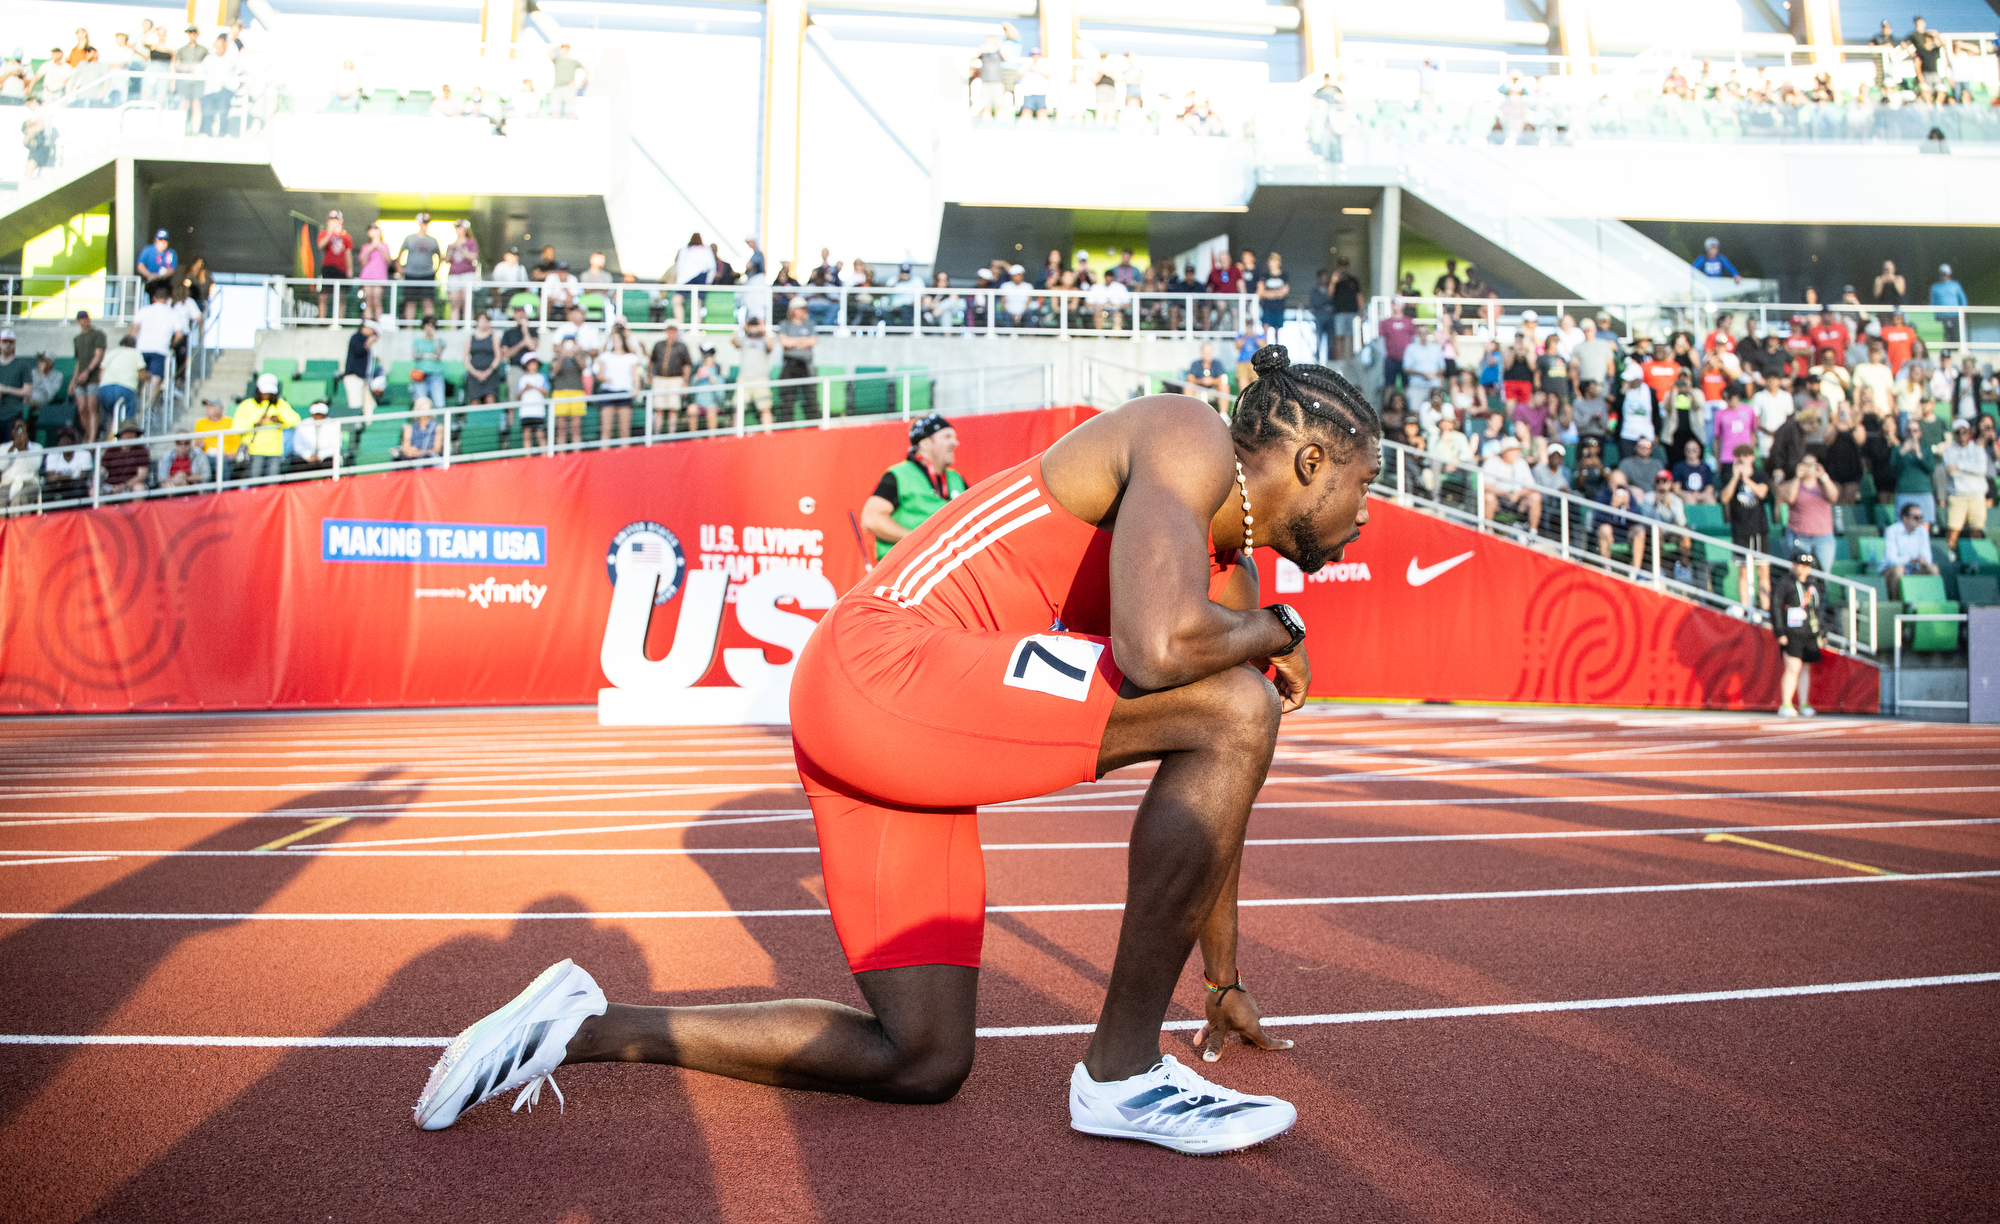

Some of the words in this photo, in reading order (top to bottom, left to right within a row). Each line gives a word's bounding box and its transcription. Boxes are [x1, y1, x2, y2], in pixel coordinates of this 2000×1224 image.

[329, 525, 422, 557] MAKING
[426, 528, 488, 559] TEAM
[493, 530, 541, 561] USA
[700, 524, 739, 553] U.S.
[742, 526, 824, 556] OLYMPIC
[468, 576, 548, 609] xfinity
[1013, 640, 1087, 682] 7
